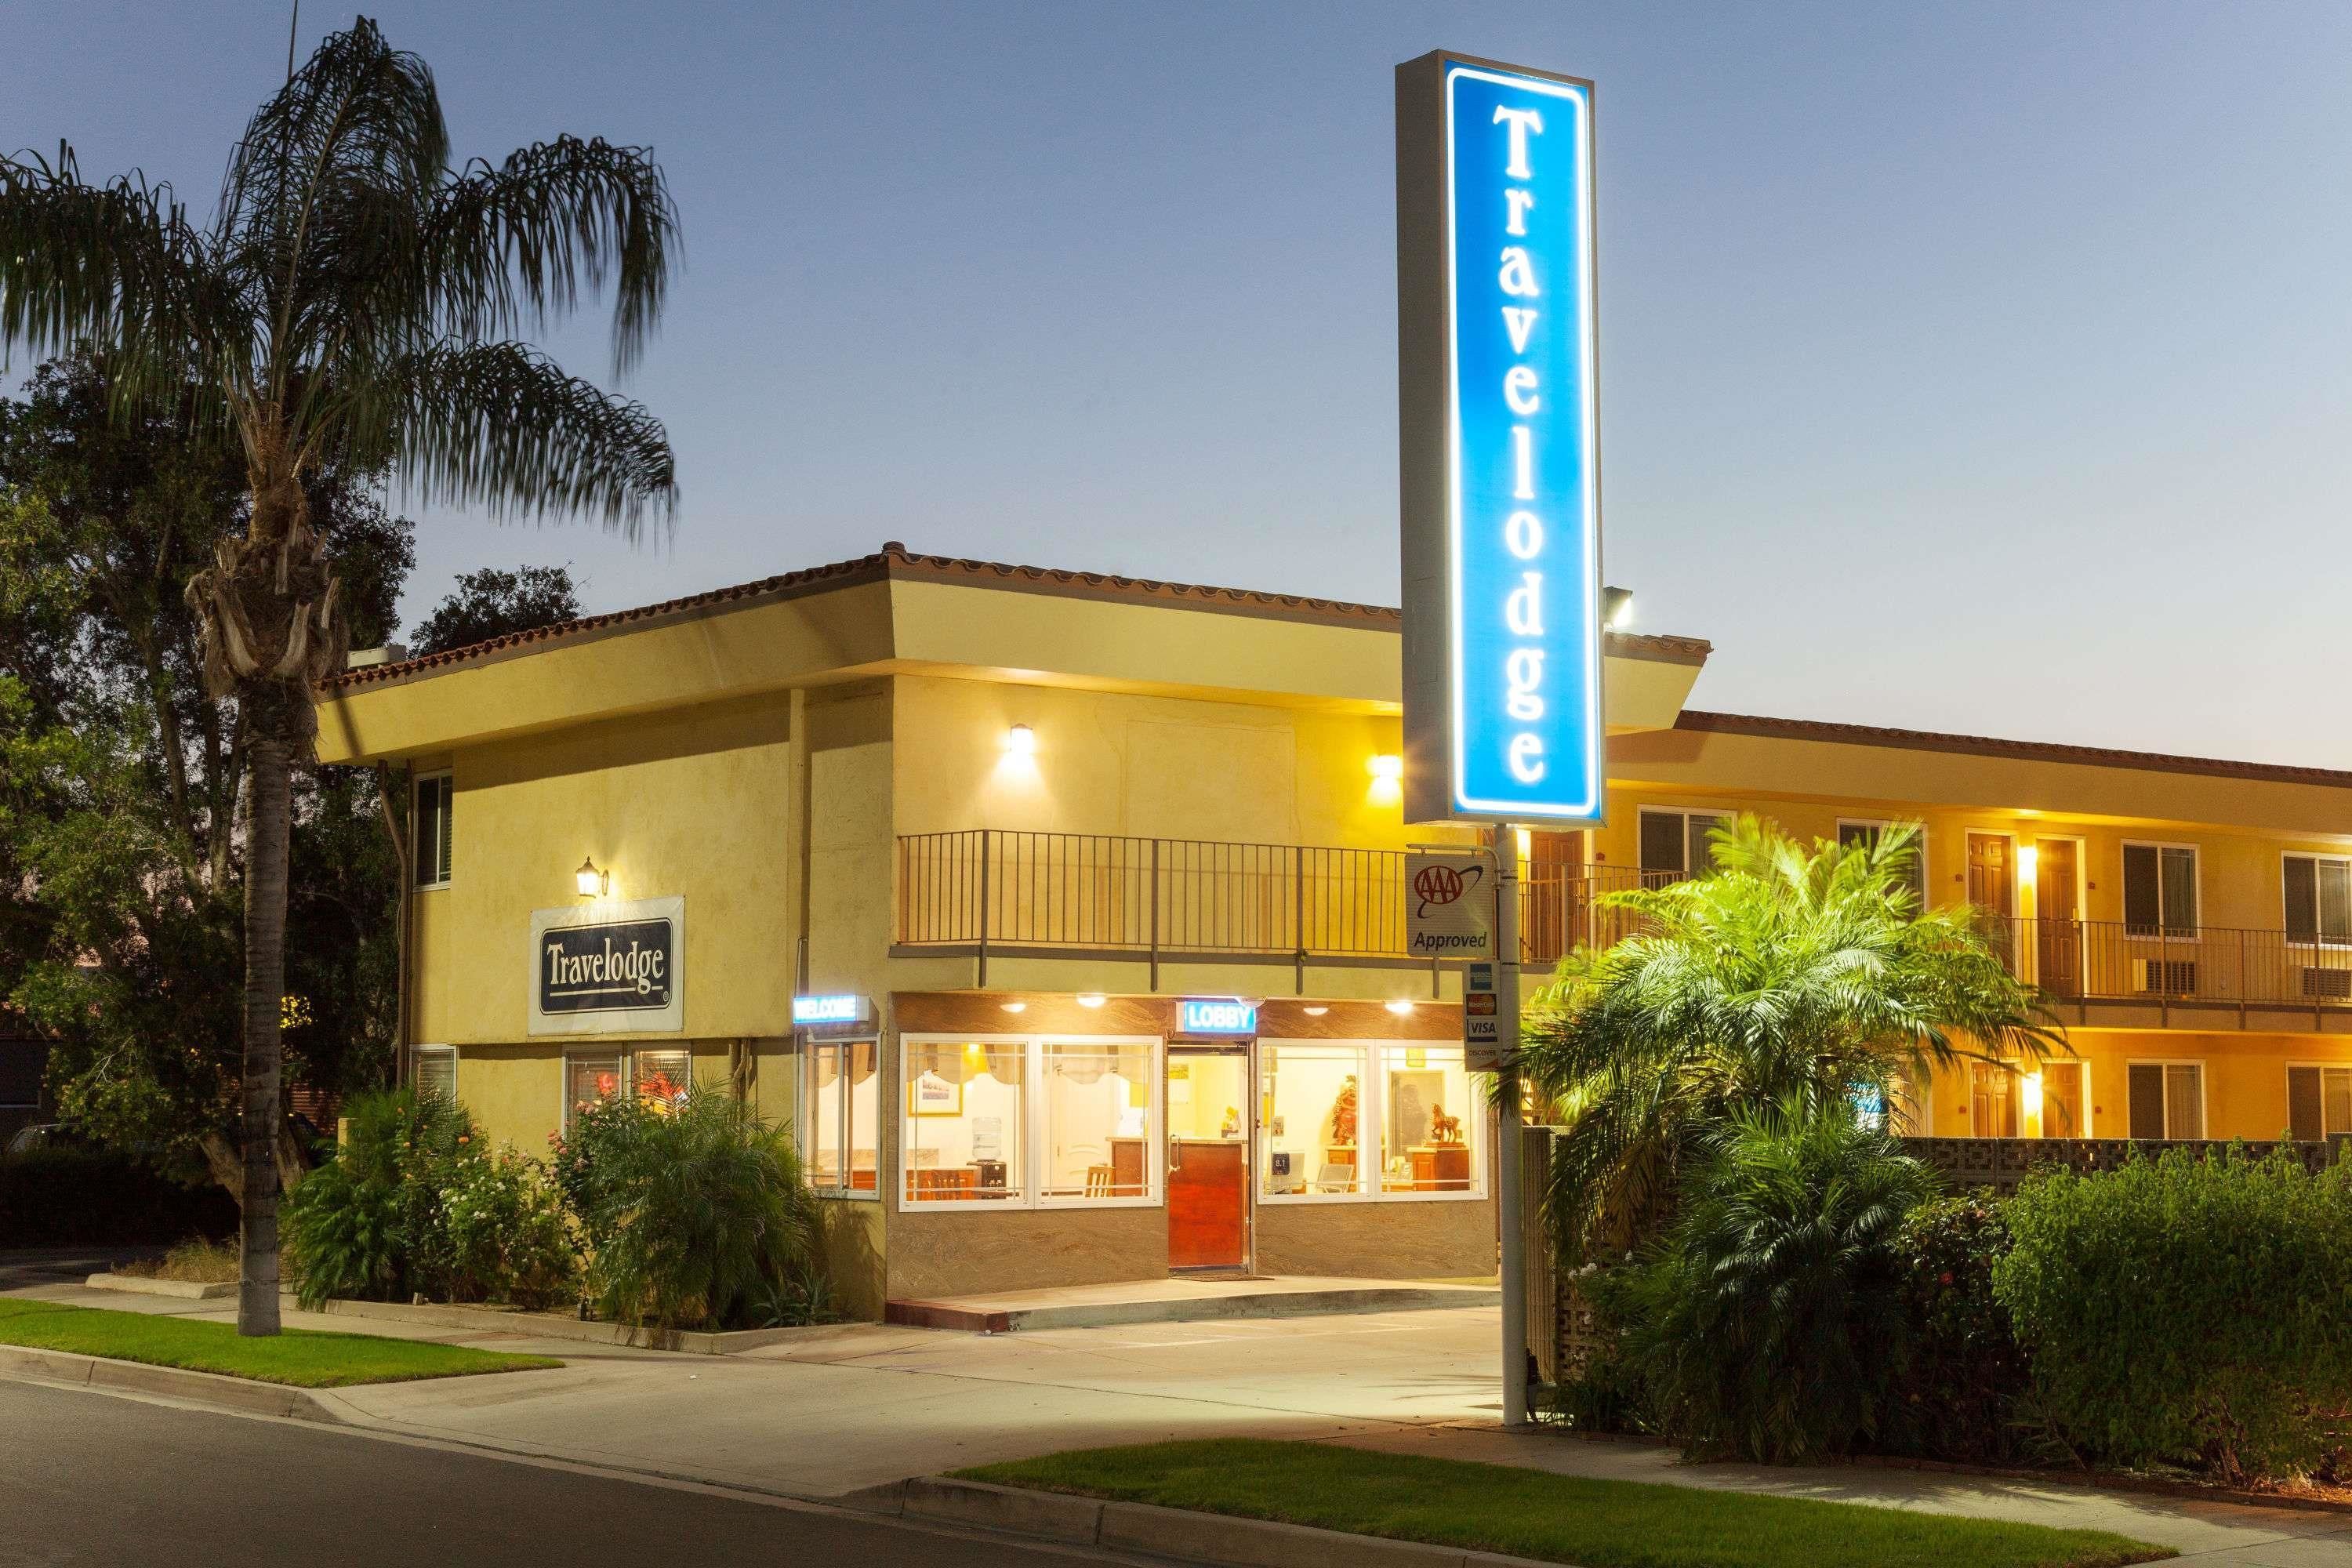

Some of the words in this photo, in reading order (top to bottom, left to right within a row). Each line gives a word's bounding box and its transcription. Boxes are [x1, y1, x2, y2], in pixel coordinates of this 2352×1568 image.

[1492, 105, 1544, 783] Travelodge
[1417, 866, 1458, 903] AAA
[1414, 932, 1487, 951] Approved
[547, 938, 664, 994] Travelodge
[1189, 1004, 1252, 1028] LOBBY
[1471, 1022, 1496, 1033] VISA
